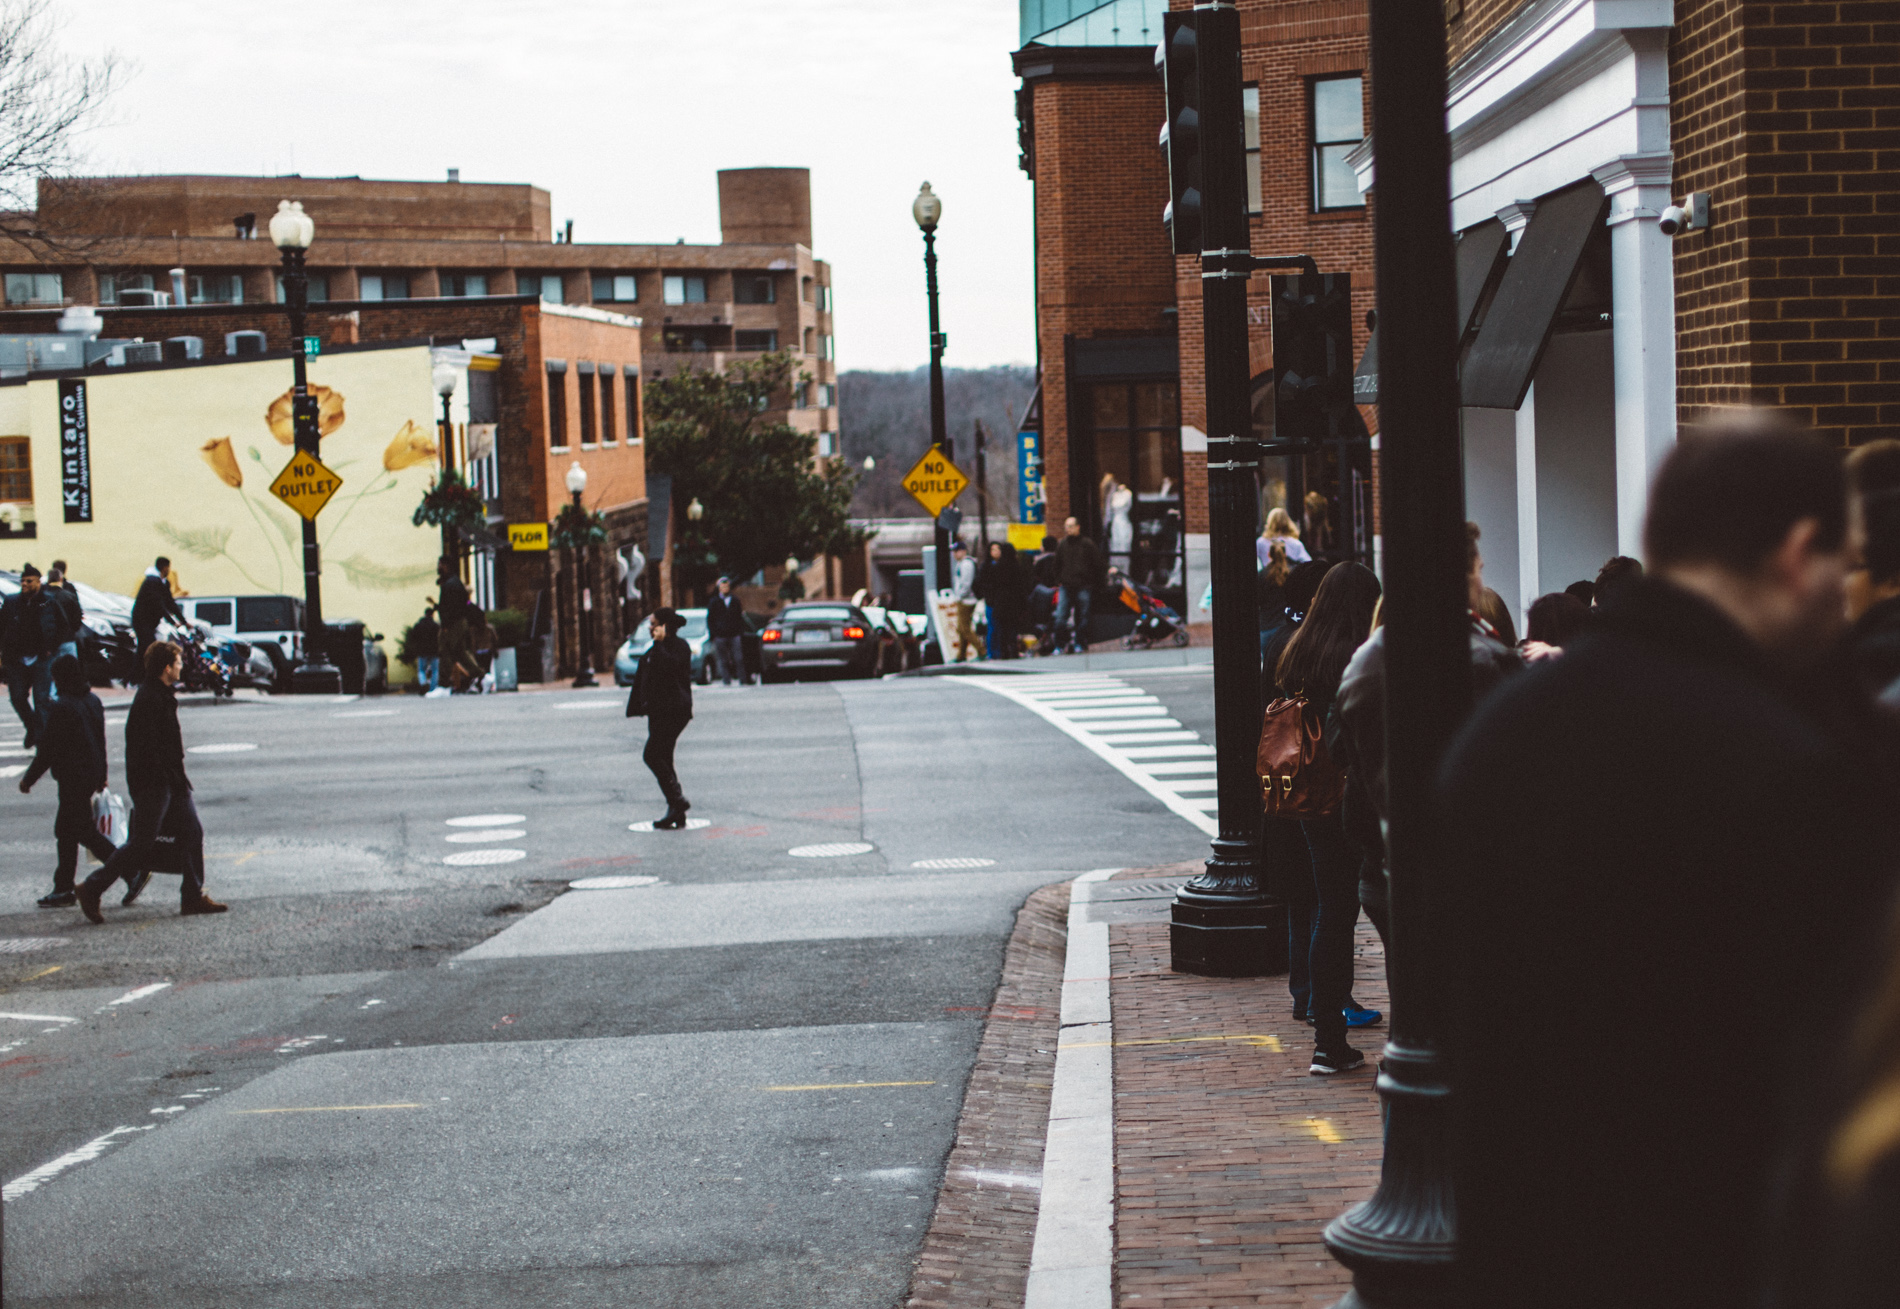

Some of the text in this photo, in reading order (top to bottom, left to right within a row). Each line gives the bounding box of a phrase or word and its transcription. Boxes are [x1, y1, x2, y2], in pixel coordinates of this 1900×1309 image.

[62, 395, 80, 507] Kintaro
[75, 385, 90, 518] Fine Japanese Cuisine
[293, 463, 315, 478] NO
[924, 462, 944, 474] NO
[279, 479, 334, 498] OUTLET
[910, 479, 959, 493] OUTLET
